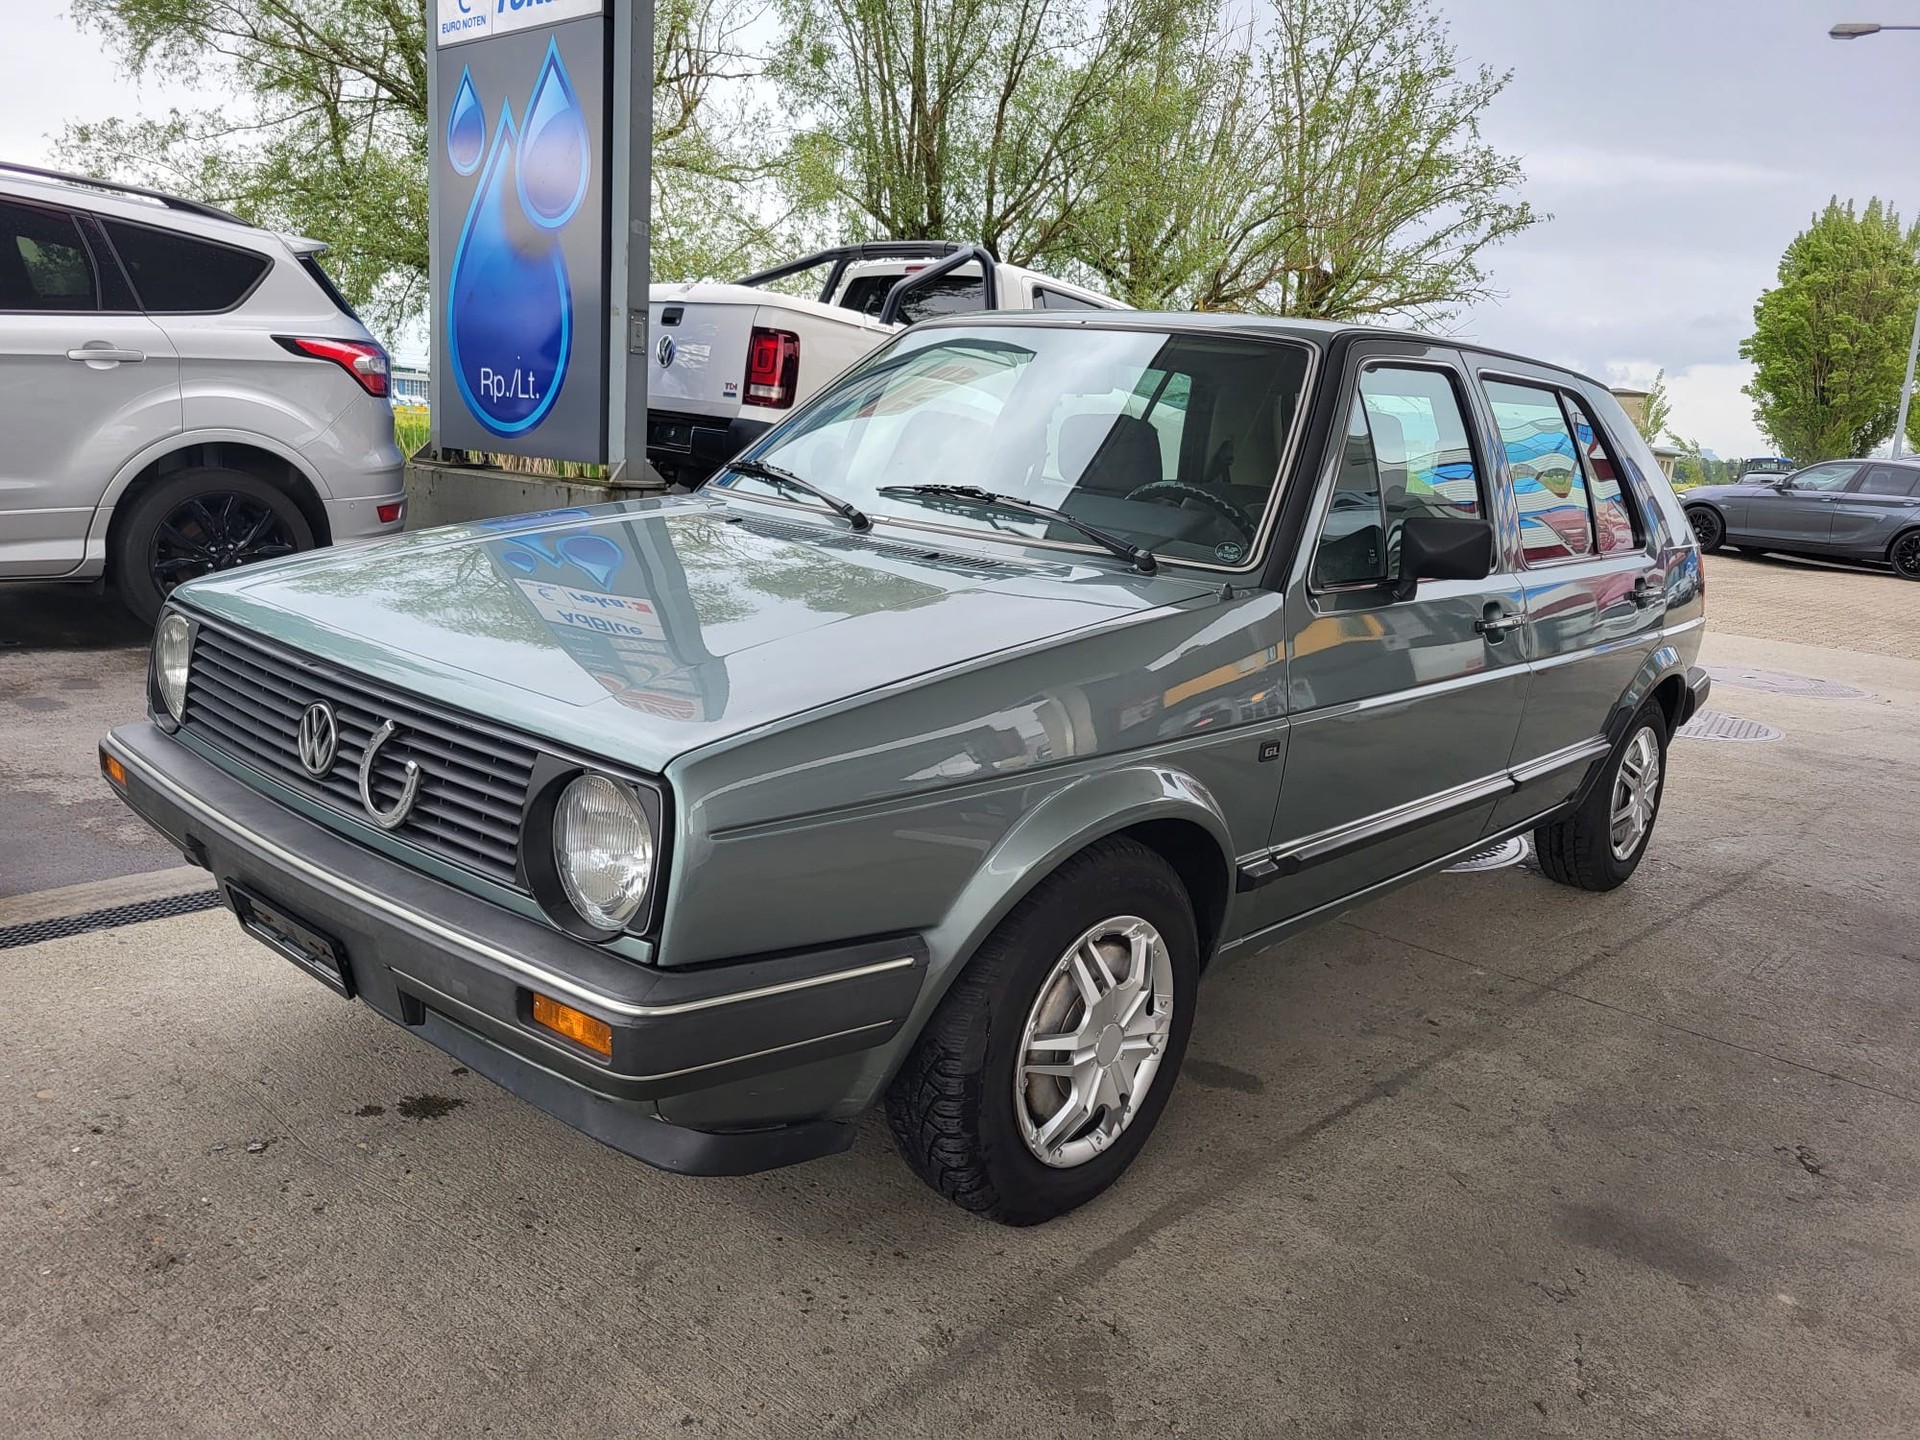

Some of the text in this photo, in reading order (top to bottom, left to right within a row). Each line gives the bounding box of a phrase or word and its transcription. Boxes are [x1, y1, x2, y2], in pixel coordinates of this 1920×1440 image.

[442, 15, 486, 34] EURO NOTEN
[480, 367, 540, 403] Rp./Lt.
[1265, 746, 1279, 757] GL
